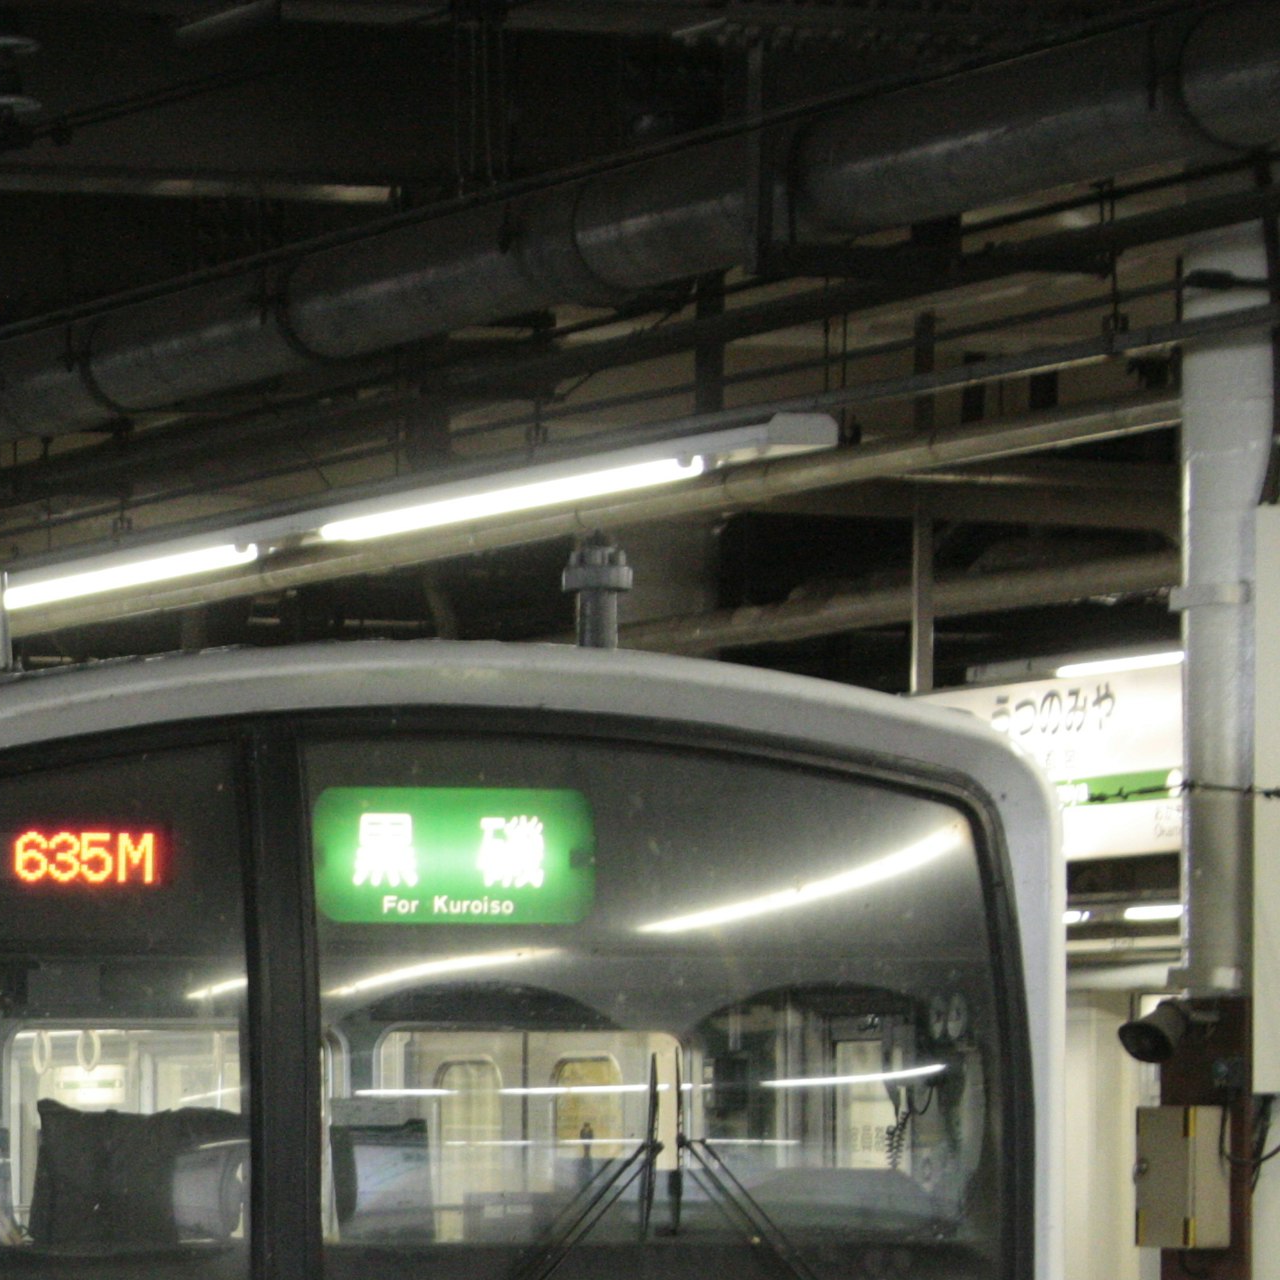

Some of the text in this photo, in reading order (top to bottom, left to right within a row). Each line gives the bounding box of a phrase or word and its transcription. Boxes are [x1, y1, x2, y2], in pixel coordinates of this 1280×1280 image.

[14, 831, 154, 884] 635M
[383, 895, 515, 914] For Kuroiso
